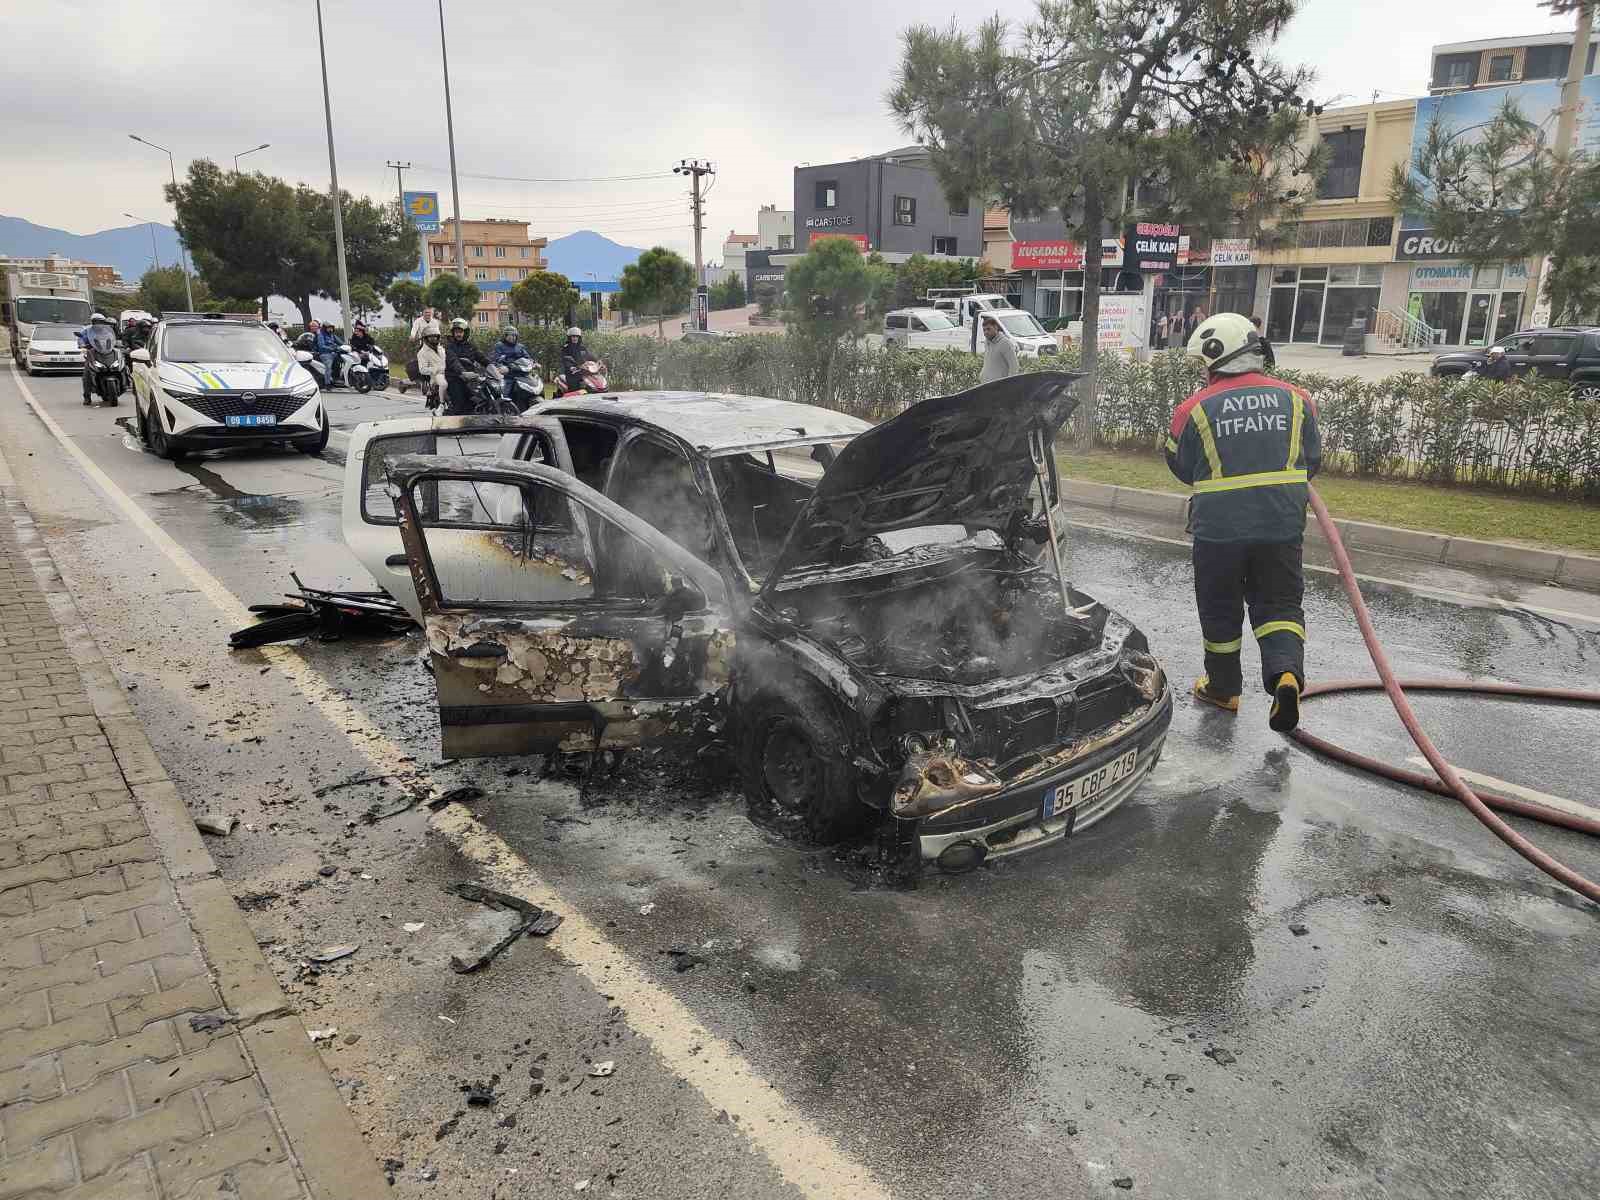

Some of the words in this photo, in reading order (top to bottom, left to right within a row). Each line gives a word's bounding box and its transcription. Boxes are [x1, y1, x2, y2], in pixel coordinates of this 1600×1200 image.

[814, 215, 852, 227] CARSTORE
[1017, 246, 1068, 259] KUŞADASI
[1135, 239, 1158, 254] ÇELİK
[1159, 241, 1178, 254] KAPI
[1214, 251, 1233, 263] ÇELİK
[1222, 392, 1279, 414] AYDIN
[246, 416, 252, 425] A
[1215, 411, 1288, 438] İTFAİYE
[1056, 783, 1074, 811] 35
[1081, 768, 1107, 799] CBP
[1111, 751, 1136, 781] 219
